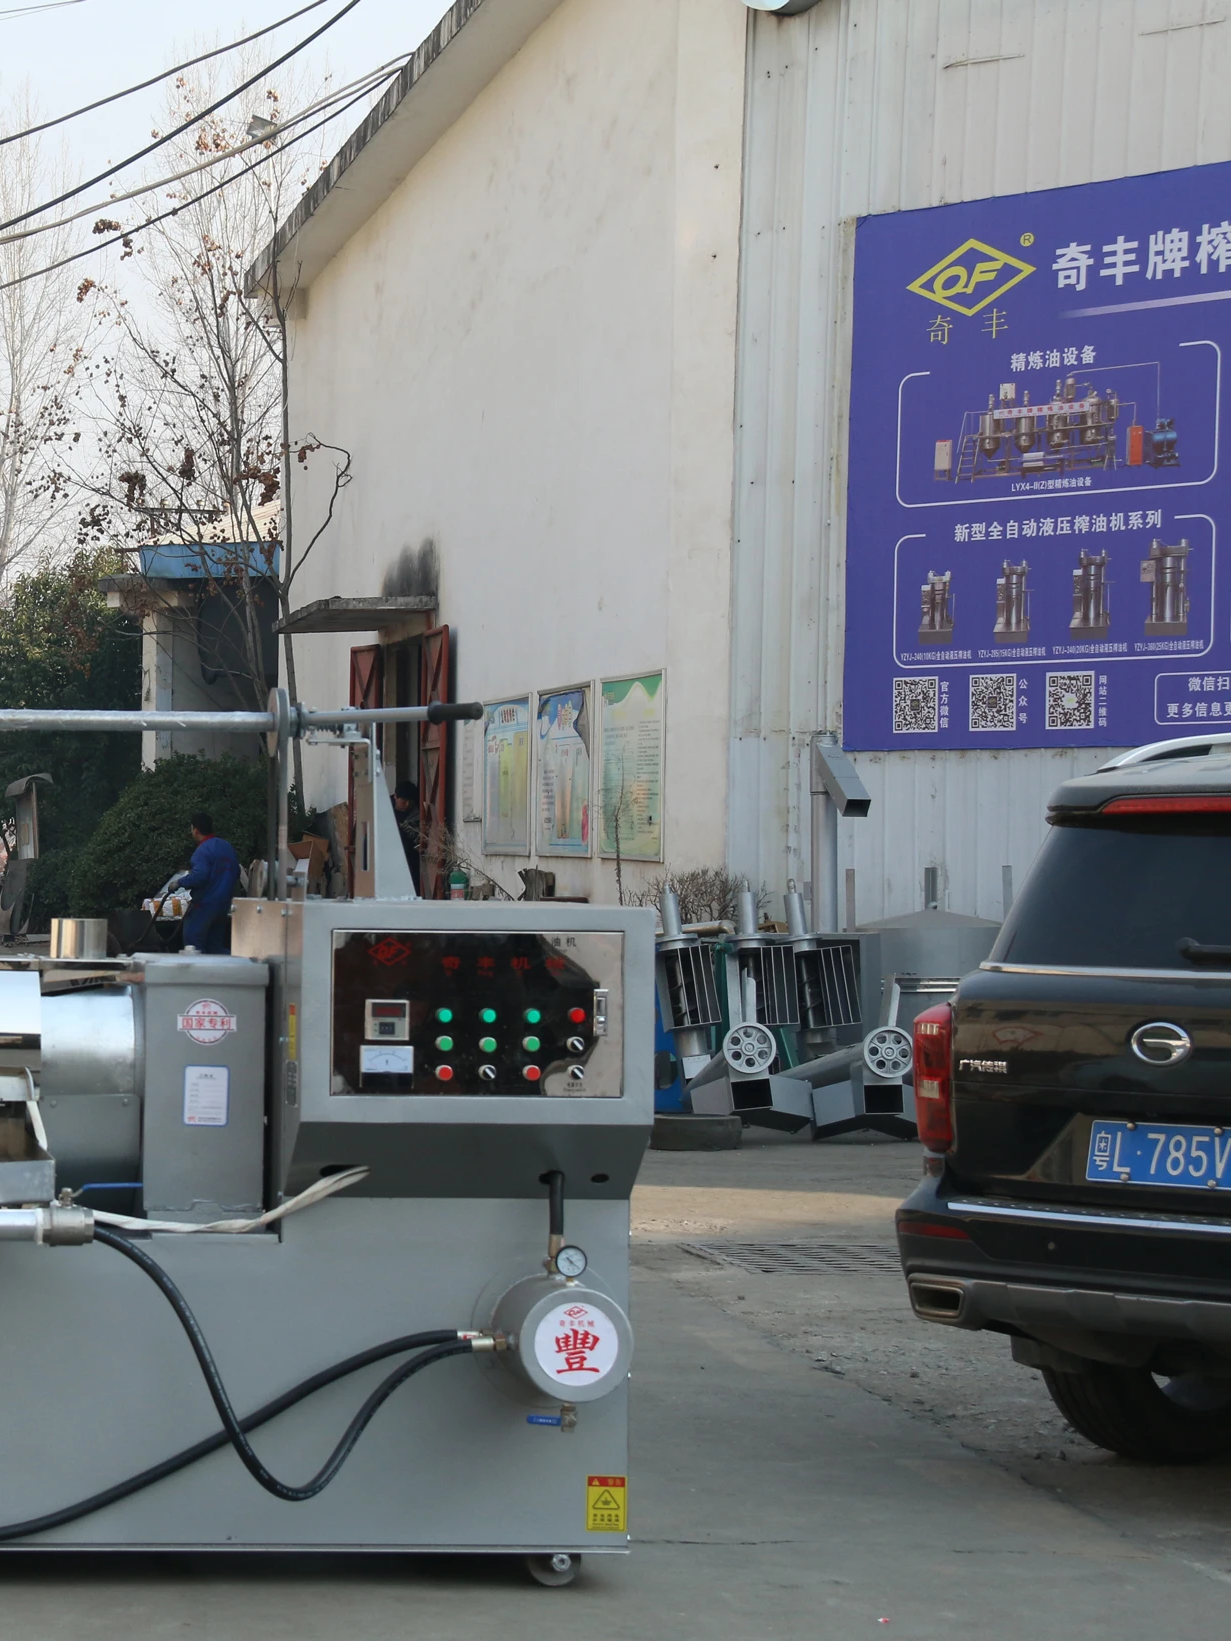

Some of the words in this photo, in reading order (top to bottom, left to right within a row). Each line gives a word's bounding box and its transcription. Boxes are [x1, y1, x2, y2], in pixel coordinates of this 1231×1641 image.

[1010, 345, 1096, 372] 精炼油设备
[954, 509, 1162, 542] 新型全自动液压榨油机系列
[1188, 676, 1230, 692] 微信扫
[939, 681, 949, 729] 官方微信
[1018, 678, 1028, 724] 公众号
[1098, 675, 1107, 727] 网站二维码
[182, 1017, 231, 1029] 国家专利
